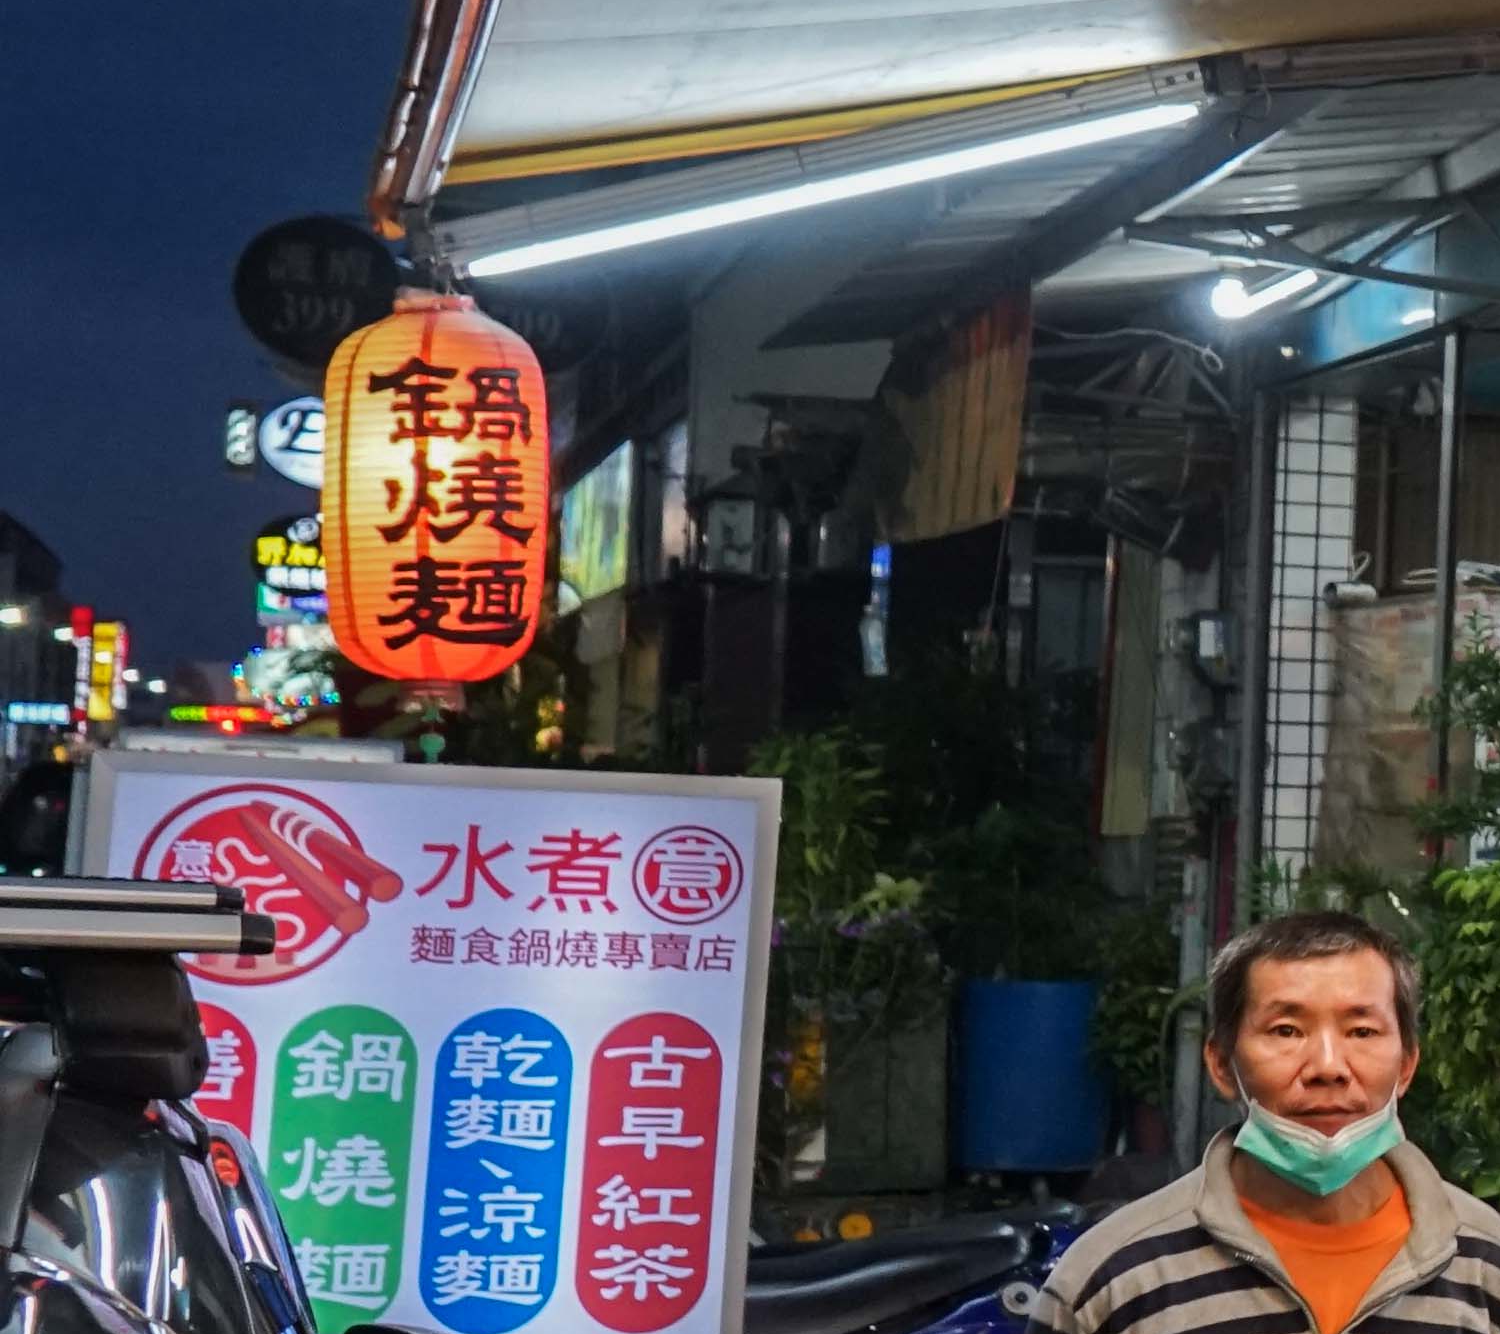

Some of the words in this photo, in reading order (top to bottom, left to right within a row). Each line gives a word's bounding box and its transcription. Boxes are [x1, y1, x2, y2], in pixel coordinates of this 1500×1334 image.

[368, 357, 537, 650] 鍋燒麵
[409, 922, 737, 973] 麵食鍋燒專賣店
[414, 824, 744, 926] 水煮意
[280, 1029, 407, 1310] 鍋燒麵
[589, 1035, 712, 1302] 古早紅茶
